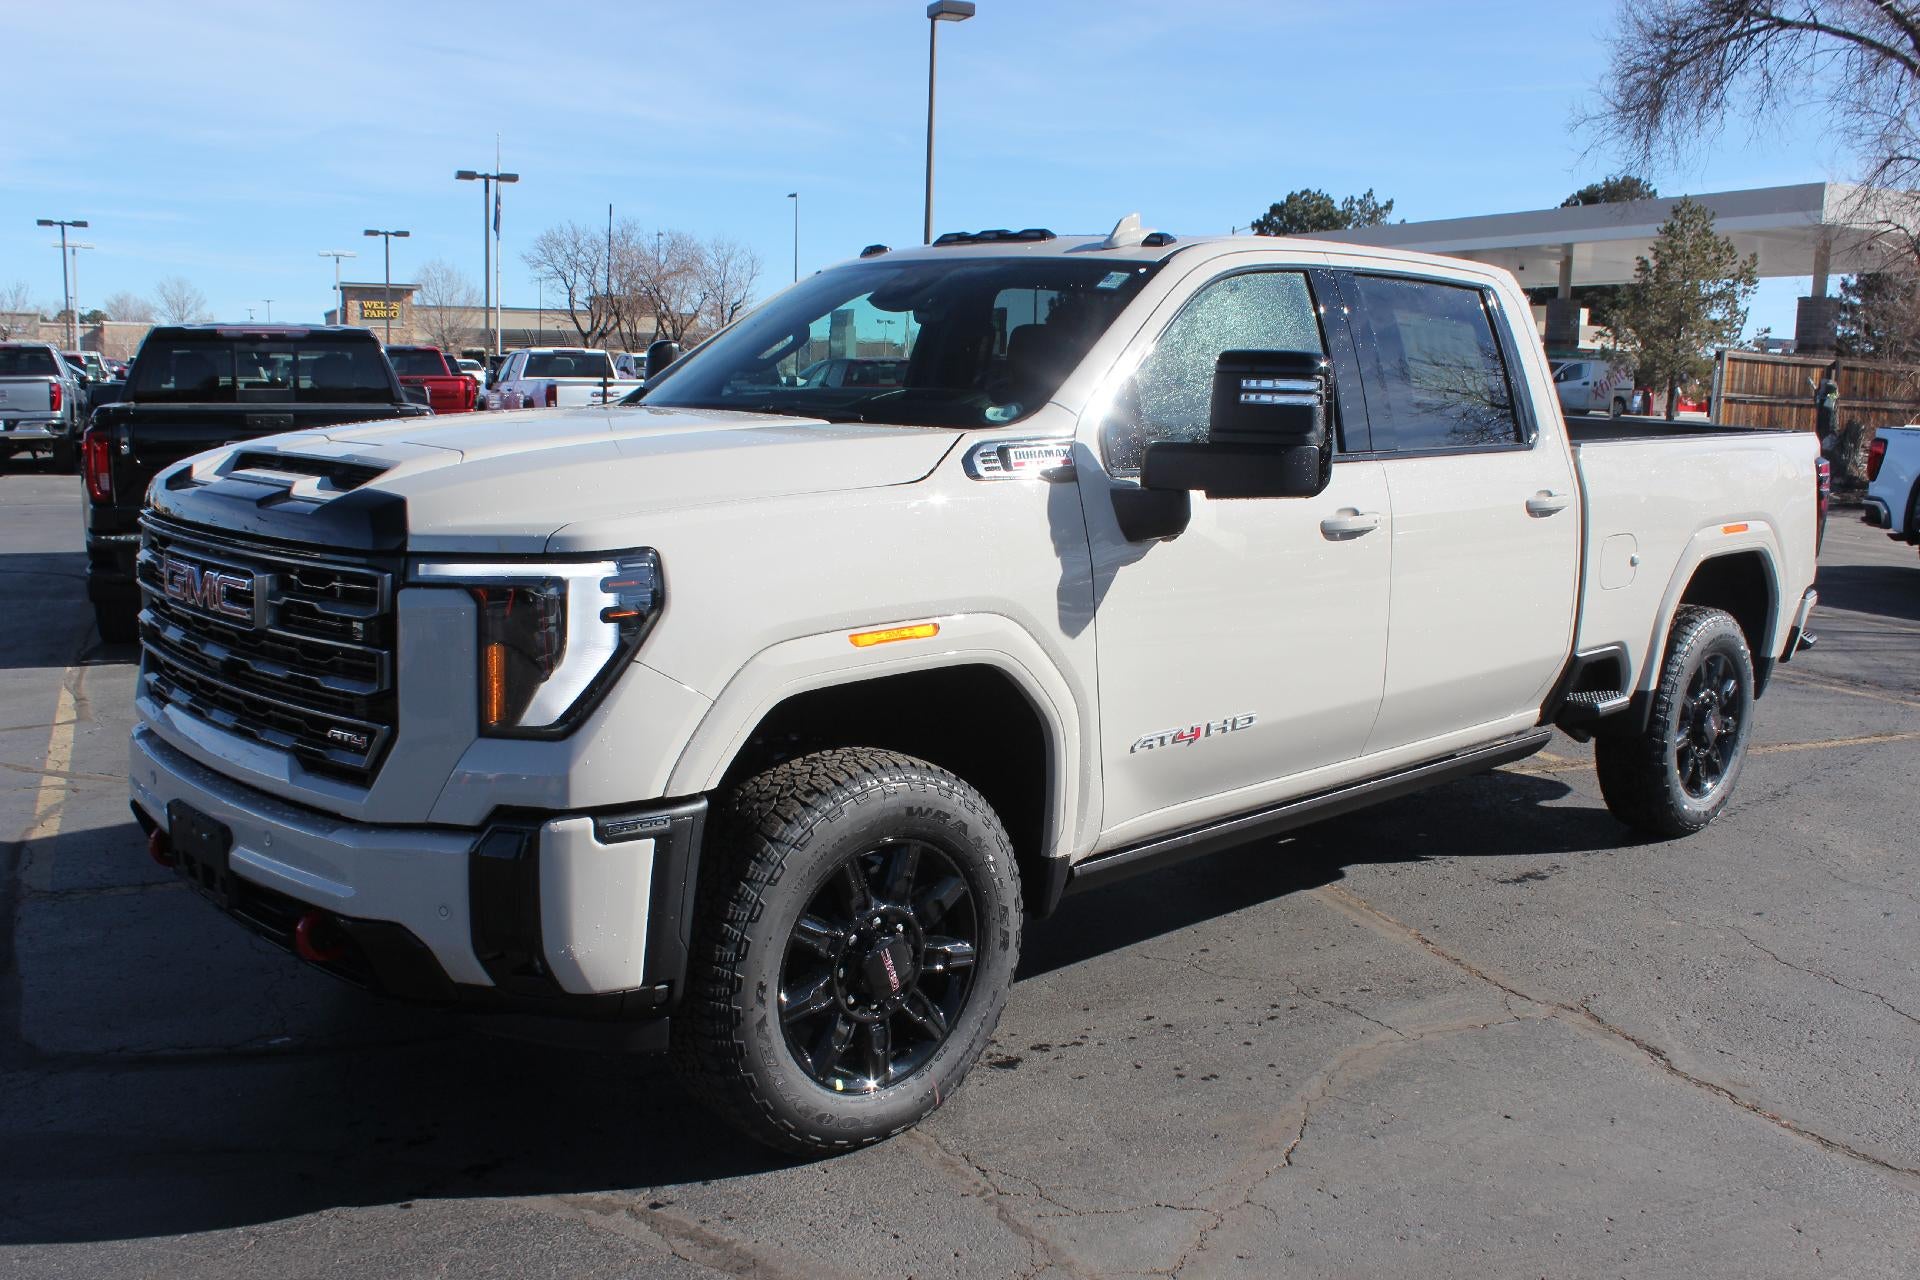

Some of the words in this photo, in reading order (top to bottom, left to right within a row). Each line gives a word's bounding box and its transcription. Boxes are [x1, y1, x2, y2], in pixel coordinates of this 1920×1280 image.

[1013, 448, 1068, 460] DURAMAX
[164, 558, 251, 618] GMC
[327, 729, 367, 749] AT4
